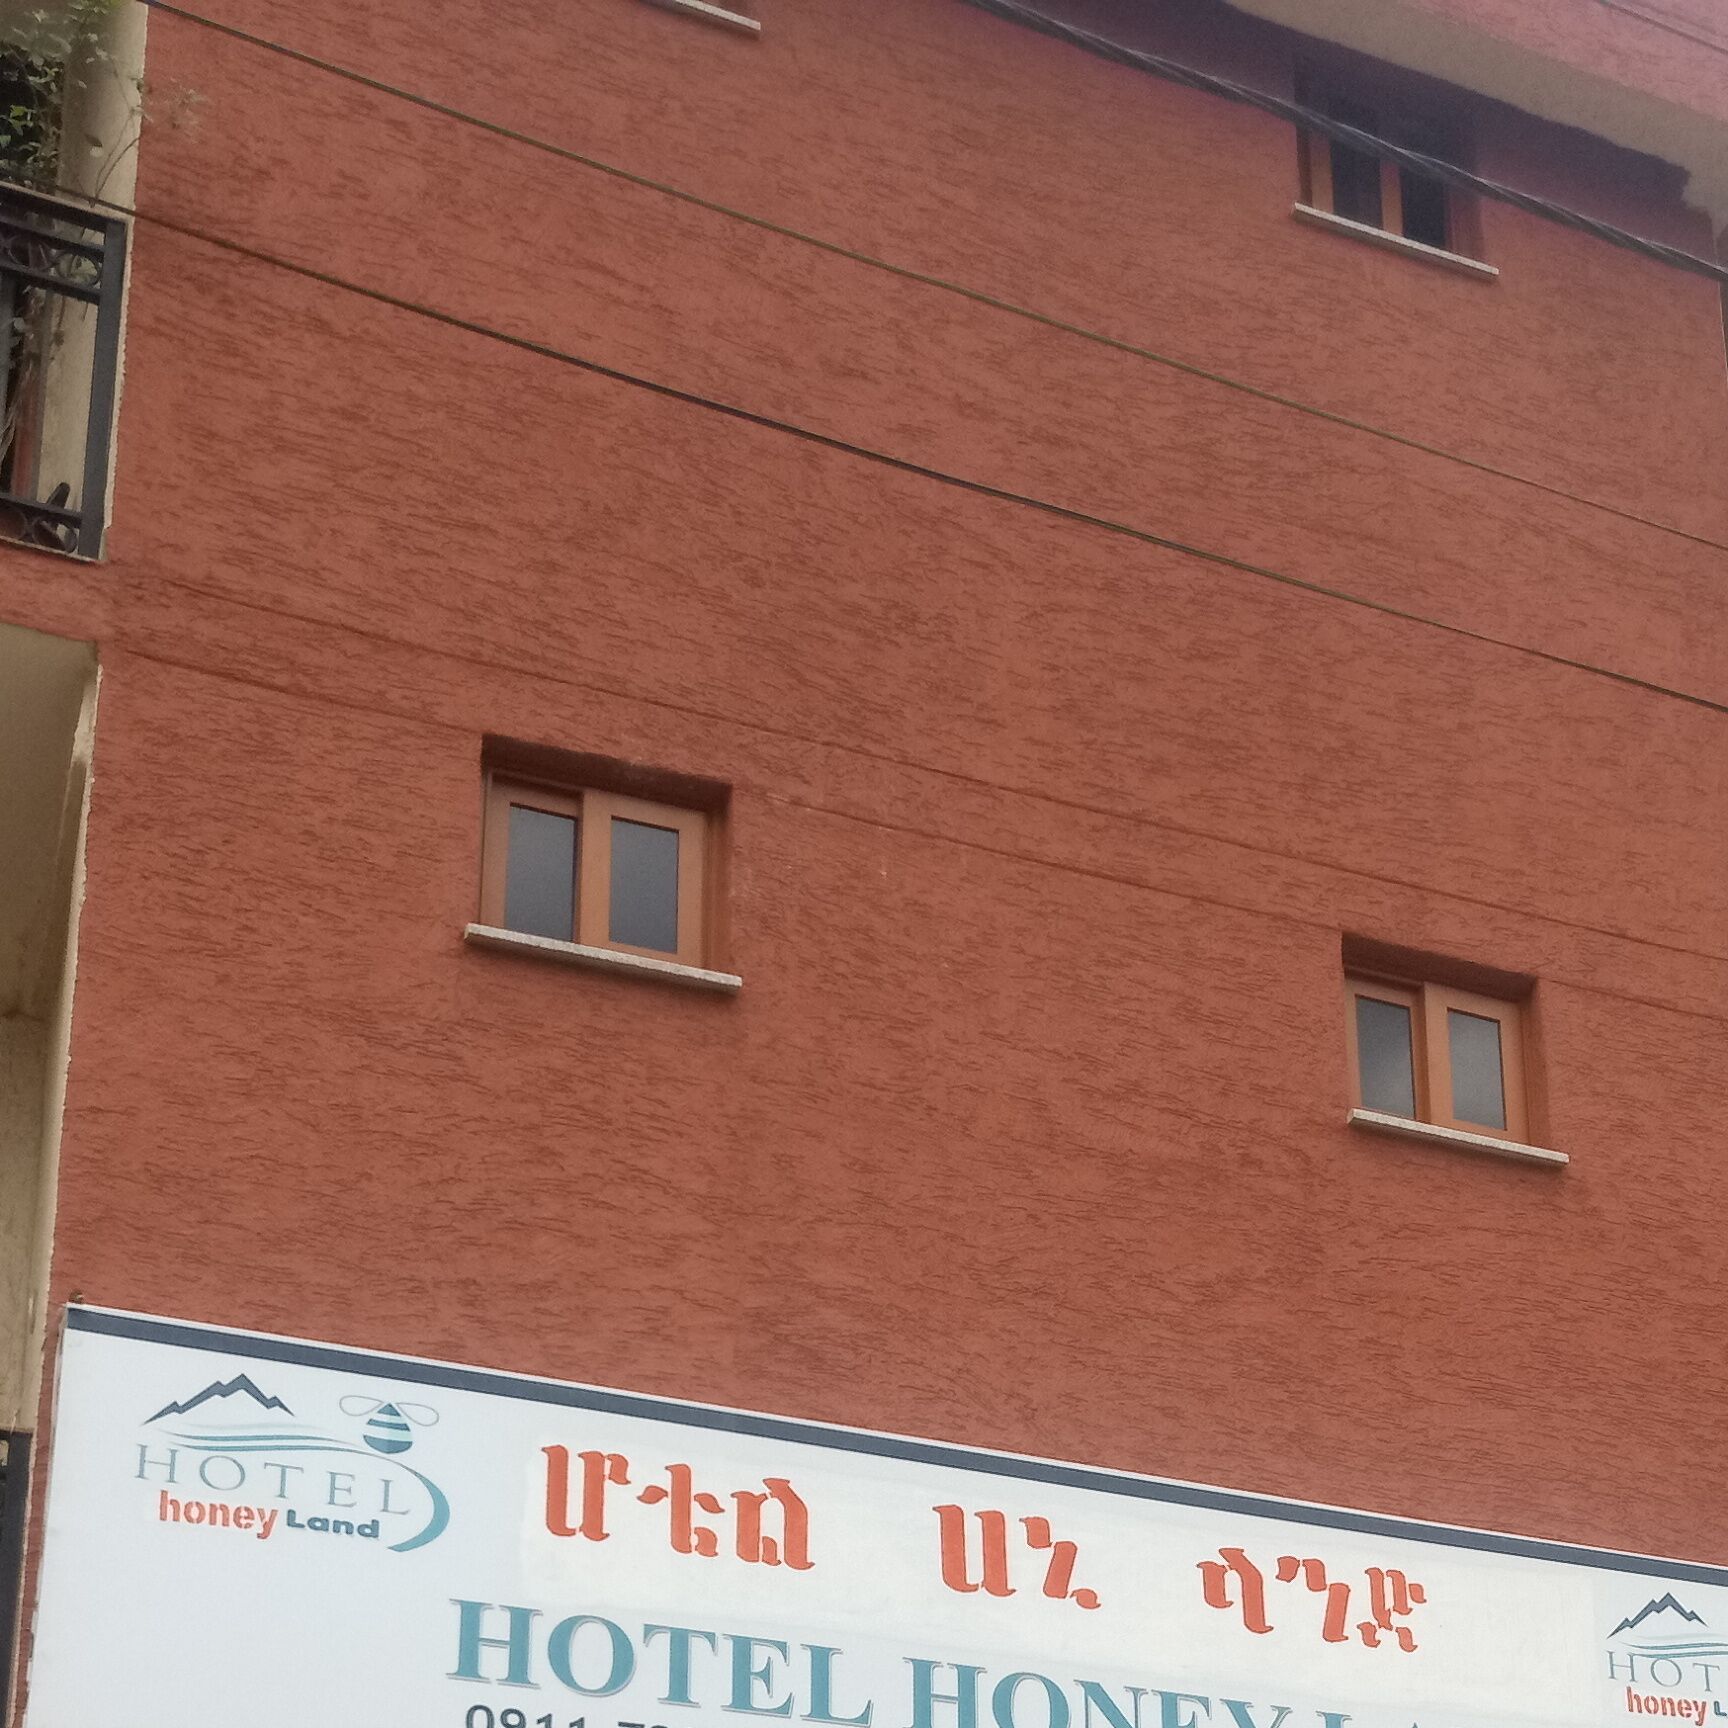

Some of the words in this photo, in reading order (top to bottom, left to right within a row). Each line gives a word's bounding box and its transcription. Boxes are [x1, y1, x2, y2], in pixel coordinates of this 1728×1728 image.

[133, 1443, 411, 1516] HOTEL
[158, 1489, 279, 1540] honey
[286, 1508, 380, 1539] Land
[445, 1597, 874, 1728] HOTEL
[1625, 1686, 1707, 1727] honey
